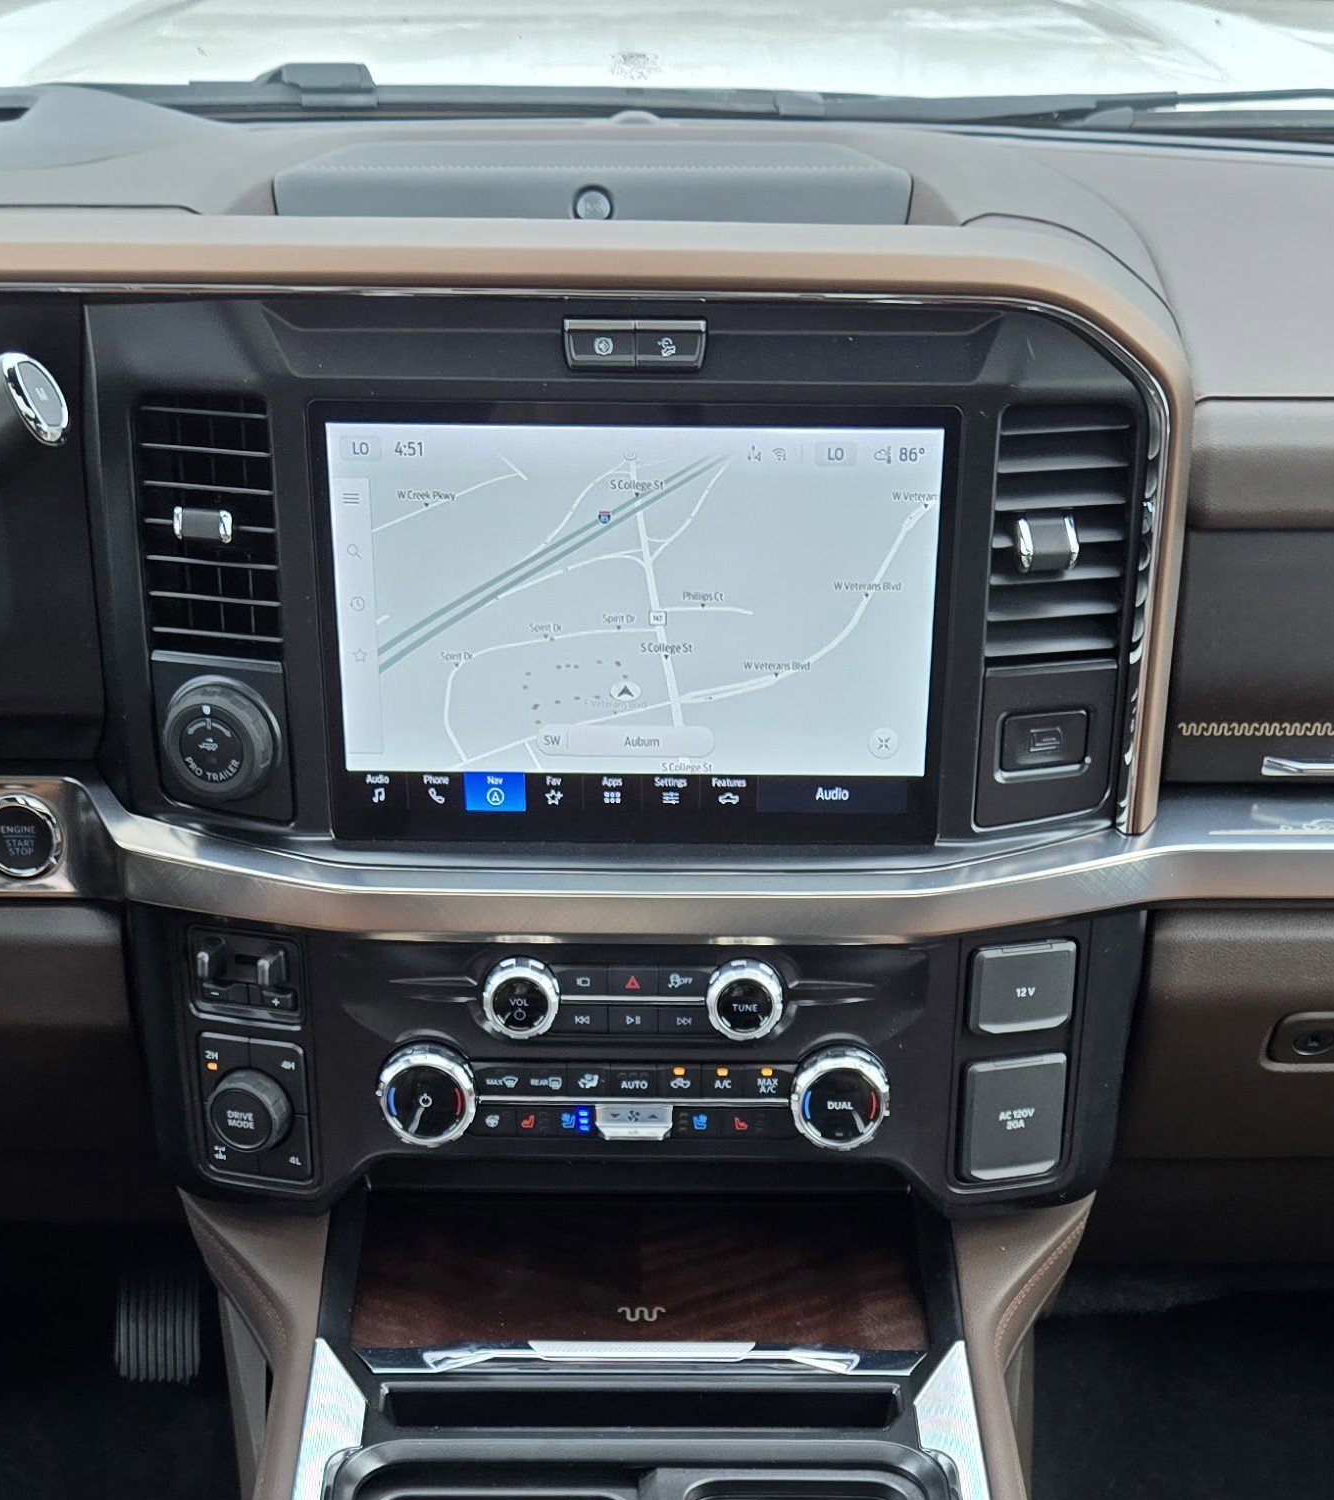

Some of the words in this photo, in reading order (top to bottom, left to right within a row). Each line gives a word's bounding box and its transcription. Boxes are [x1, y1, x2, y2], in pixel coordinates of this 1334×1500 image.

[353, 442, 369, 455] LO
[395, 442, 424, 457] 4:51
[828, 449, 844, 460] LO
[899, 448, 925, 462] 86°
[610, 480, 616, 489] S
[618, 480, 652, 491] College
[654, 480, 663, 490] St
[398, 491, 407, 500] W
[409, 491, 430, 500] Creek
[432, 491, 455, 502] Pkwy
[844, 582, 881, 590] Veterans
[883, 582, 901, 591] Blvd
[683, 592, 713, 602] Phillips
[603, 615, 624, 623] Spirit
[641, 644, 647, 652] S
[648, 644, 681, 654] College
[683, 644, 692, 652] St
[744, 662, 753, 670] W
[754, 661, 790, 671] Veterans
[792, 661, 810, 671] Blvd
[544, 736, 561, 745] SW
[624, 737, 660, 747] Auburn
[185, 756, 203, 777] PRO
[207, 759, 240, 783] TRAILER
[366, 774, 389, 784] Audio
[423, 775, 449, 785] Phone
[487, 776, 503, 785] Nav
[546, 776, 561, 786] Fav
[602, 777, 622, 787] Apps
[655, 778, 687, 788] Settings
[712, 777, 747, 788] Features
[815, 787, 849, 801] Audio
[6, 839, 34, 847] START
[509, 998, 529, 1007] VOL
[732, 1004, 758, 1013] TUNE
[621, 1080, 648, 1089] AUTO
[714, 1080, 732, 1089] A/C
[757, 1078, 778, 1087] MAX
[760, 1085, 777, 1093] A/C
[827, 1101, 854, 1110] DUAL
[227, 1110, 254, 1121] DRIVE
[228, 1119, 255, 1129] MODE
